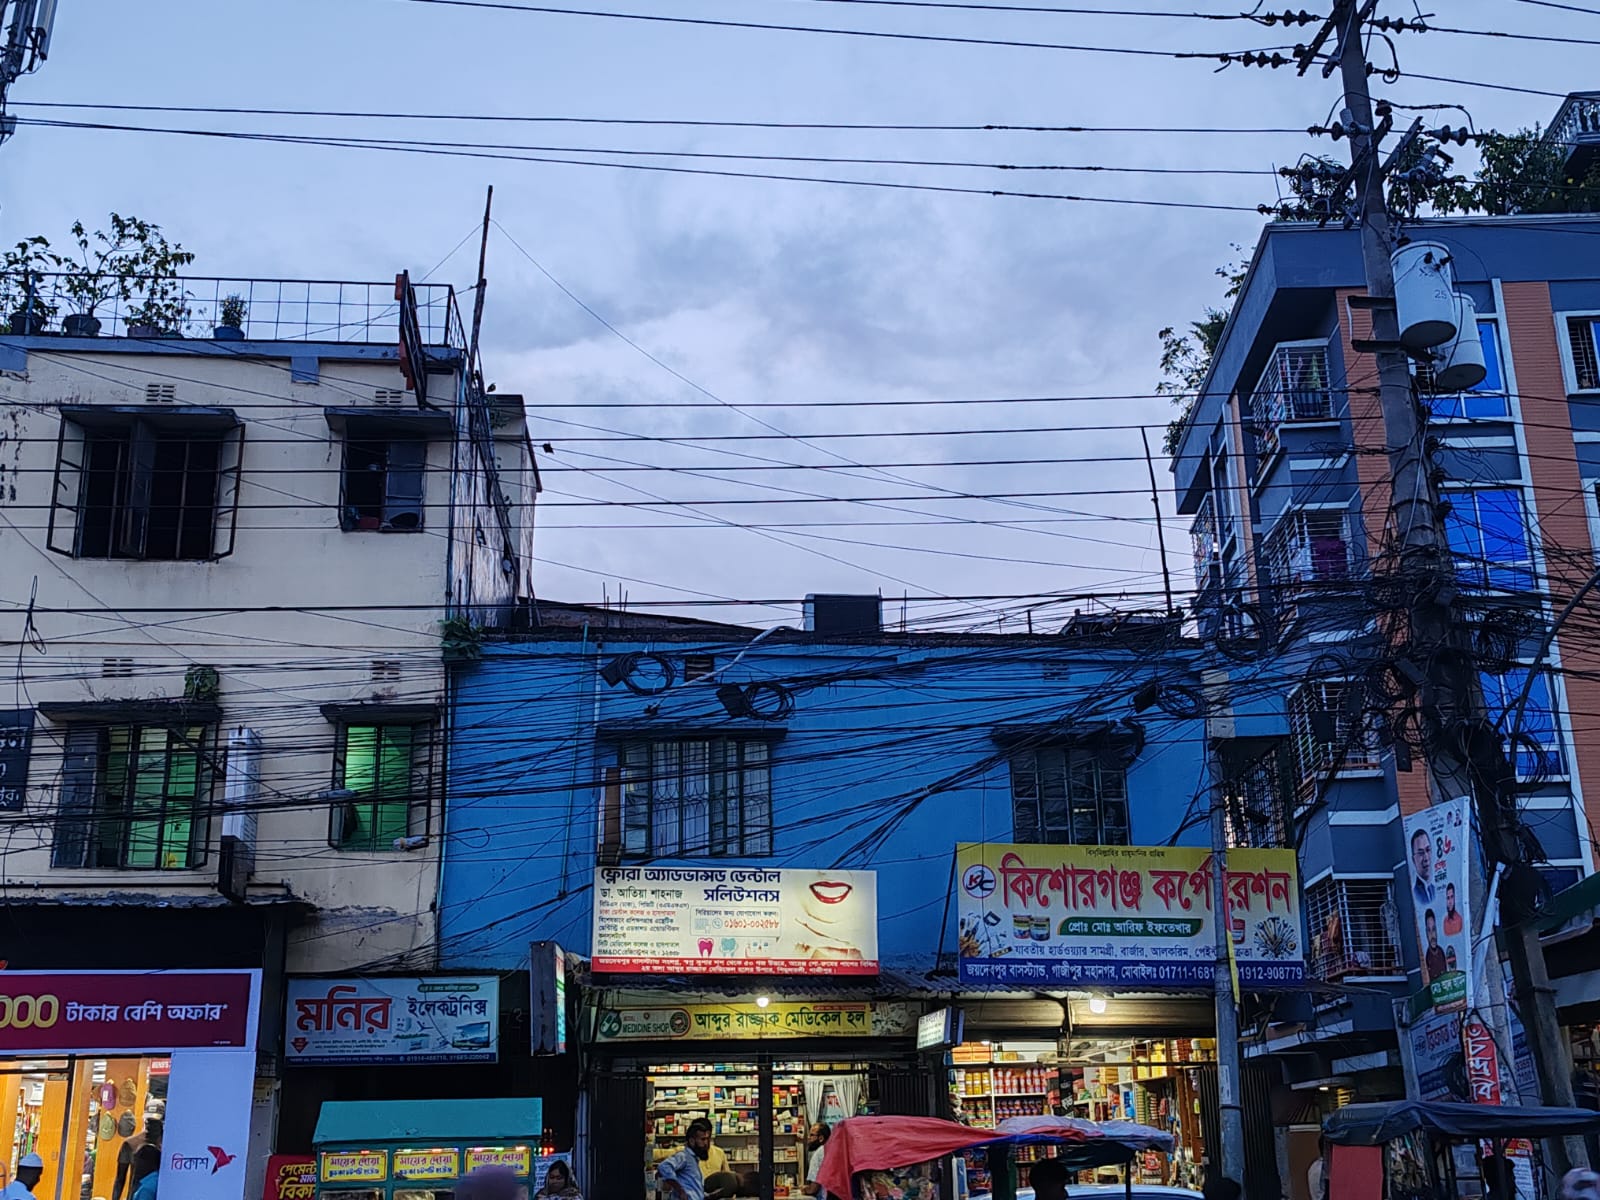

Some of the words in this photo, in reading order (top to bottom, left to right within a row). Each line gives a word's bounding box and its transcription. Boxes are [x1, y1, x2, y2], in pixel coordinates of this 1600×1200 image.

[601, 868, 640, 884] ফ্লোরা
[644, 868, 727, 883] অ্যাডভান্সড
[730, 868, 781, 883] ডেন্টাল
[999, 852, 1143, 912] কিশোরগঞ্জ
[616, 885, 647, 899] আতিয়া
[651, 888, 683, 900] শাহনাজ
[704, 884, 780, 902] সলিউশনস
[1068, 921, 1088, 934] প্রোঃ
[1092, 921, 1111, 934] মোঃ
[1114, 919, 1144, 934] আরিফ
[1146, 919, 1191, 935] ইফতেখার
[965, 962, 1007, 979] জয়দেবপুর
[1052, 960, 1082, 980] গাজীপুর
[1237, 966, 1302, 981] 1912-908779
[66, 1001, 119, 1022] টাকার
[124, 1000, 163, 1022] বেশি
[295, 985, 392, 1034] মনির
[694, 1013, 730, 1031] আব্দুর
[786, 1007, 842, 1028] মেডিকেল
[847, 1012, 866, 1028] হল
[171, 1153, 209, 1170] বিকাশ
[280, 1177, 316, 1199] বিকা
